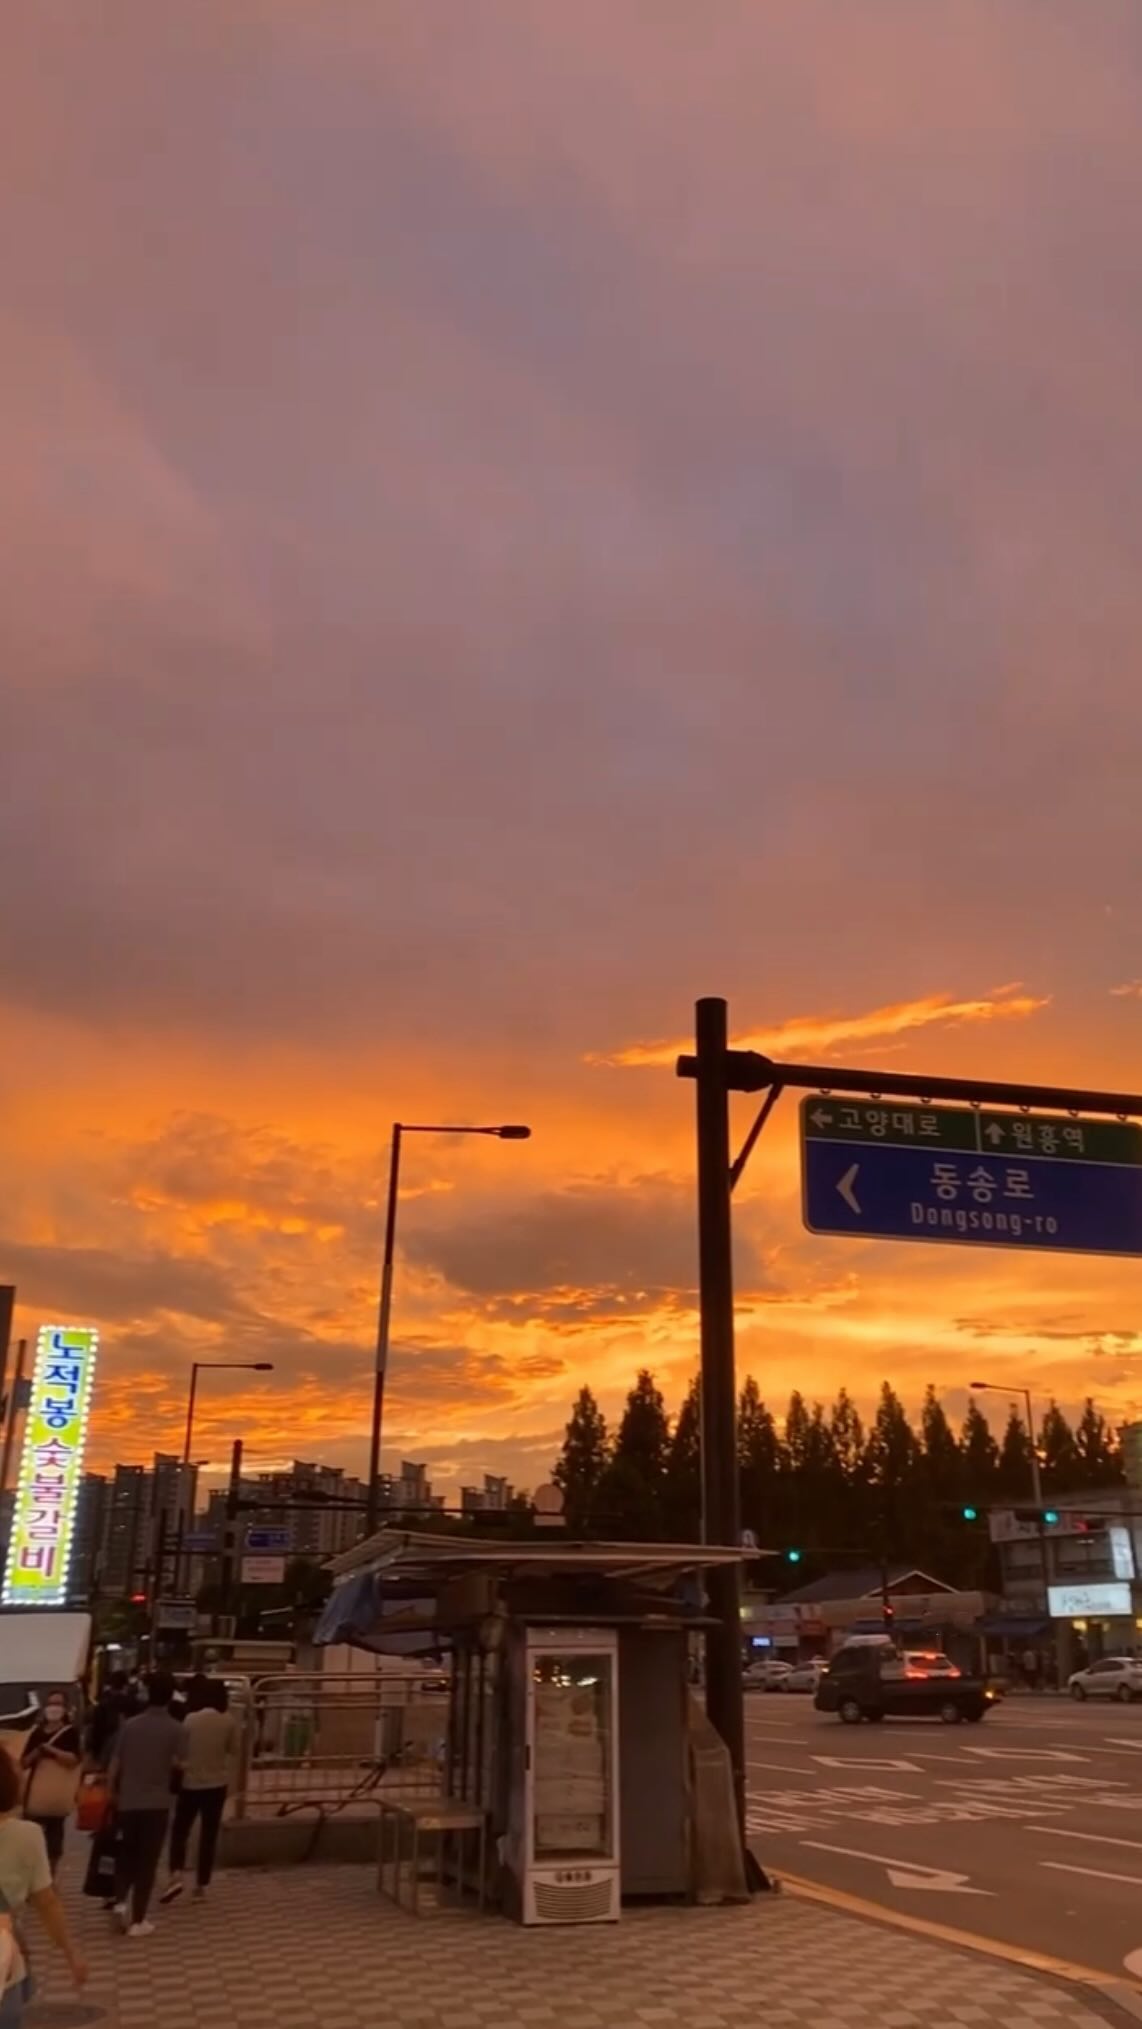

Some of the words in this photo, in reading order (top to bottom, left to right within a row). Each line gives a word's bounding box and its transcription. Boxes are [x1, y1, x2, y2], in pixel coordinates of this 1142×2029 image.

[838, 1107, 942, 1137] 고양대로
[930, 1162, 1035, 1203] 동송로
[910, 1202, 1058, 1236] Dongsong-ro
[40, 1333, 86, 1429] 노적봉
[20, 1437, 73, 1577] 숯불갈비
